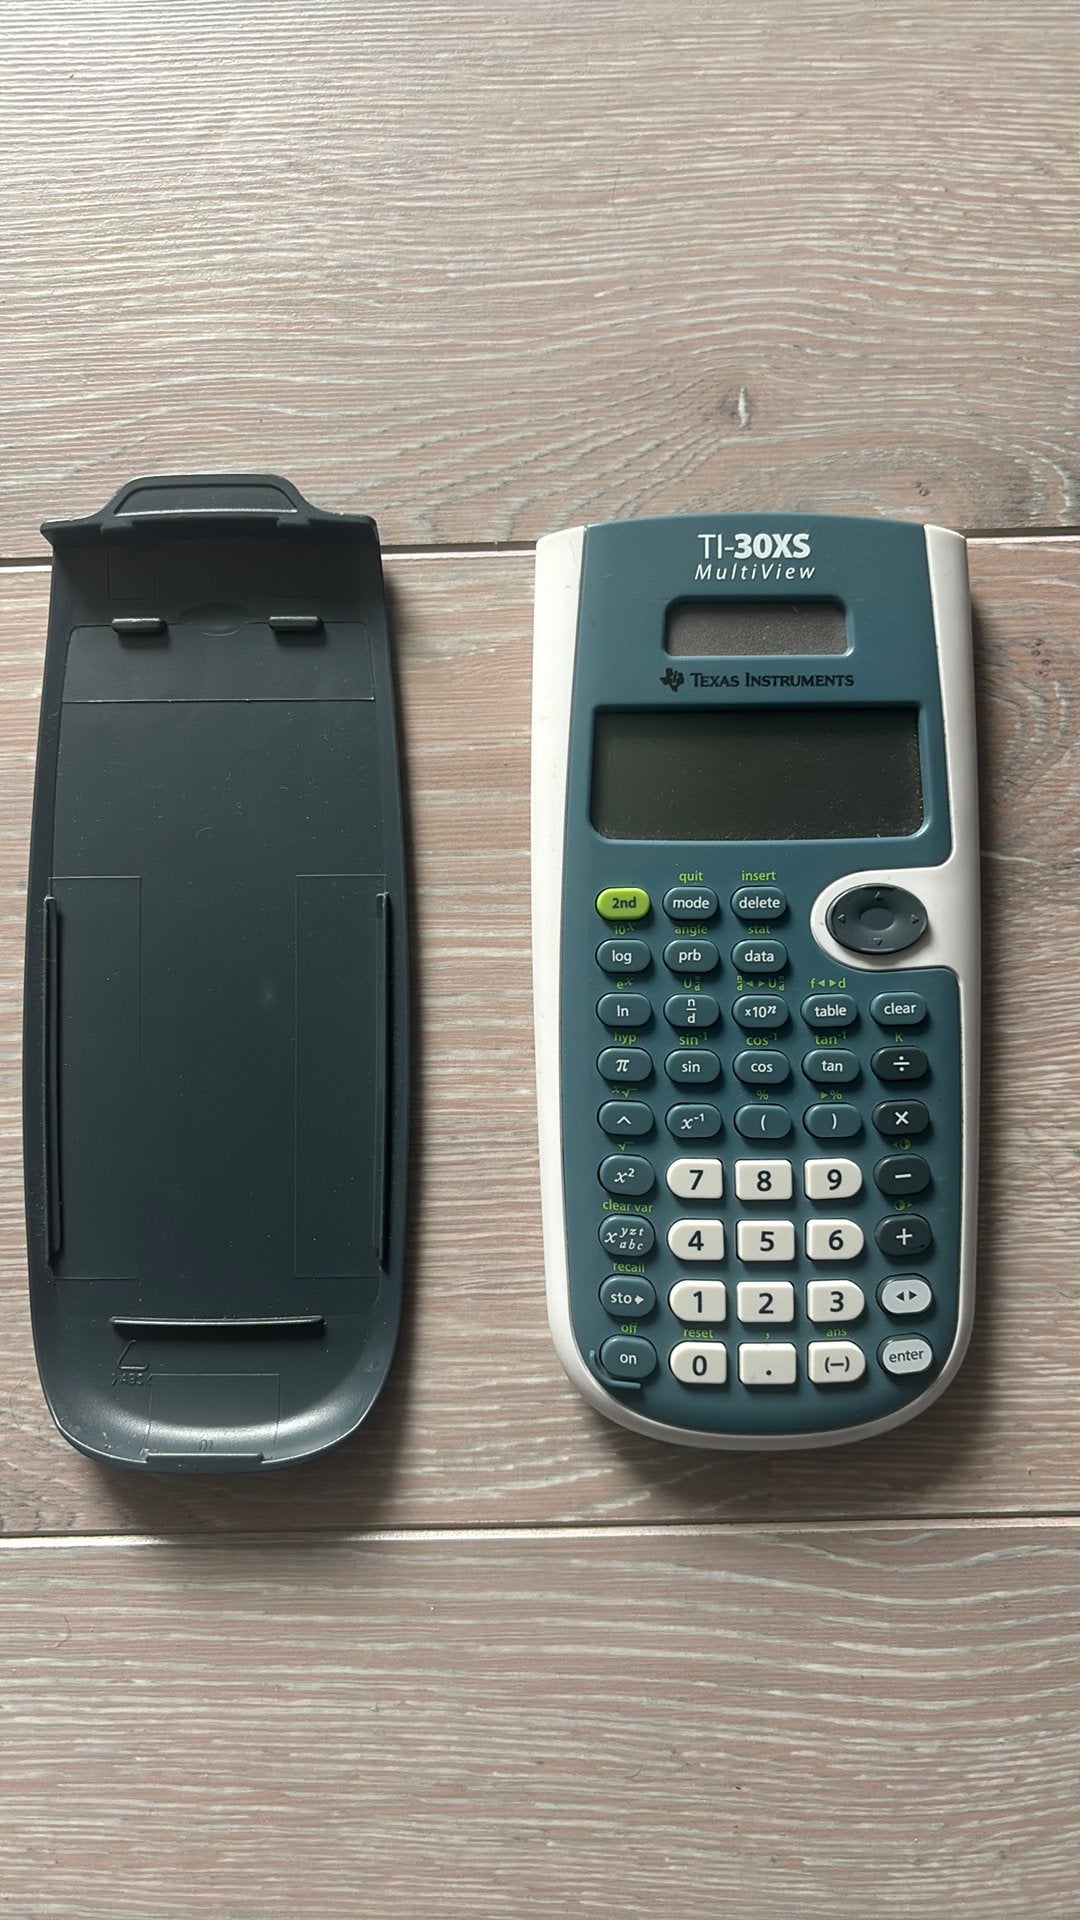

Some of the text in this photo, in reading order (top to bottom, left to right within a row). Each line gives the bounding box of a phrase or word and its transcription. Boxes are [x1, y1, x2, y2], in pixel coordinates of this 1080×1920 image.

[697, 533, 811, 559] TI-30XS
[694, 563, 816, 580] MultiView
[690, 672, 739, 688] TEXAS
[745, 672, 854, 688] INSTRUMENTS
[679, 871, 704, 882] quit
[741, 870, 776, 881] insert
[612, 896, 637, 909] 2nd
[672, 897, 710, 909] mode
[738, 896, 781, 909] delete
[674, 924, 708, 936] angle
[748, 926, 771, 935] stat
[612, 950, 632, 964] log
[678, 949, 702, 963] prb
[744, 950, 775, 962] data
[616, 1004, 630, 1017] ln
[814, 1004, 847, 1018] table
[883, 1002, 917, 1015] clear
[614, 1032, 637, 1045] hyp
[895, 1032, 904, 1043] K
[681, 1060, 701, 1073] sin
[750, 1061, 773, 1073] cos
[821, 1060, 843, 1072] tan
[689, 1169, 704, 1191] 7
[756, 1170, 772, 1192] 8
[827, 1168, 842, 1191] 9
[602, 1199, 653, 1214] clear var
[687, 1230, 704, 1252] 4
[760, 1230, 775, 1252] 5
[828, 1229, 844, 1251] 6
[612, 1261, 645, 1273] recall
[610, 1292, 632, 1305] sto
[693, 1290, 703, 1314] 1
[758, 1292, 774, 1315] 2
[829, 1290, 844, 1313] 3
[621, 1323, 638, 1334] off
[683, 1328, 714, 1339] reset
[826, 1329, 848, 1338] ans
[619, 1353, 637, 1365] on
[889, 1352, 924, 1363] enter
[692, 1355, 707, 1377] 0
